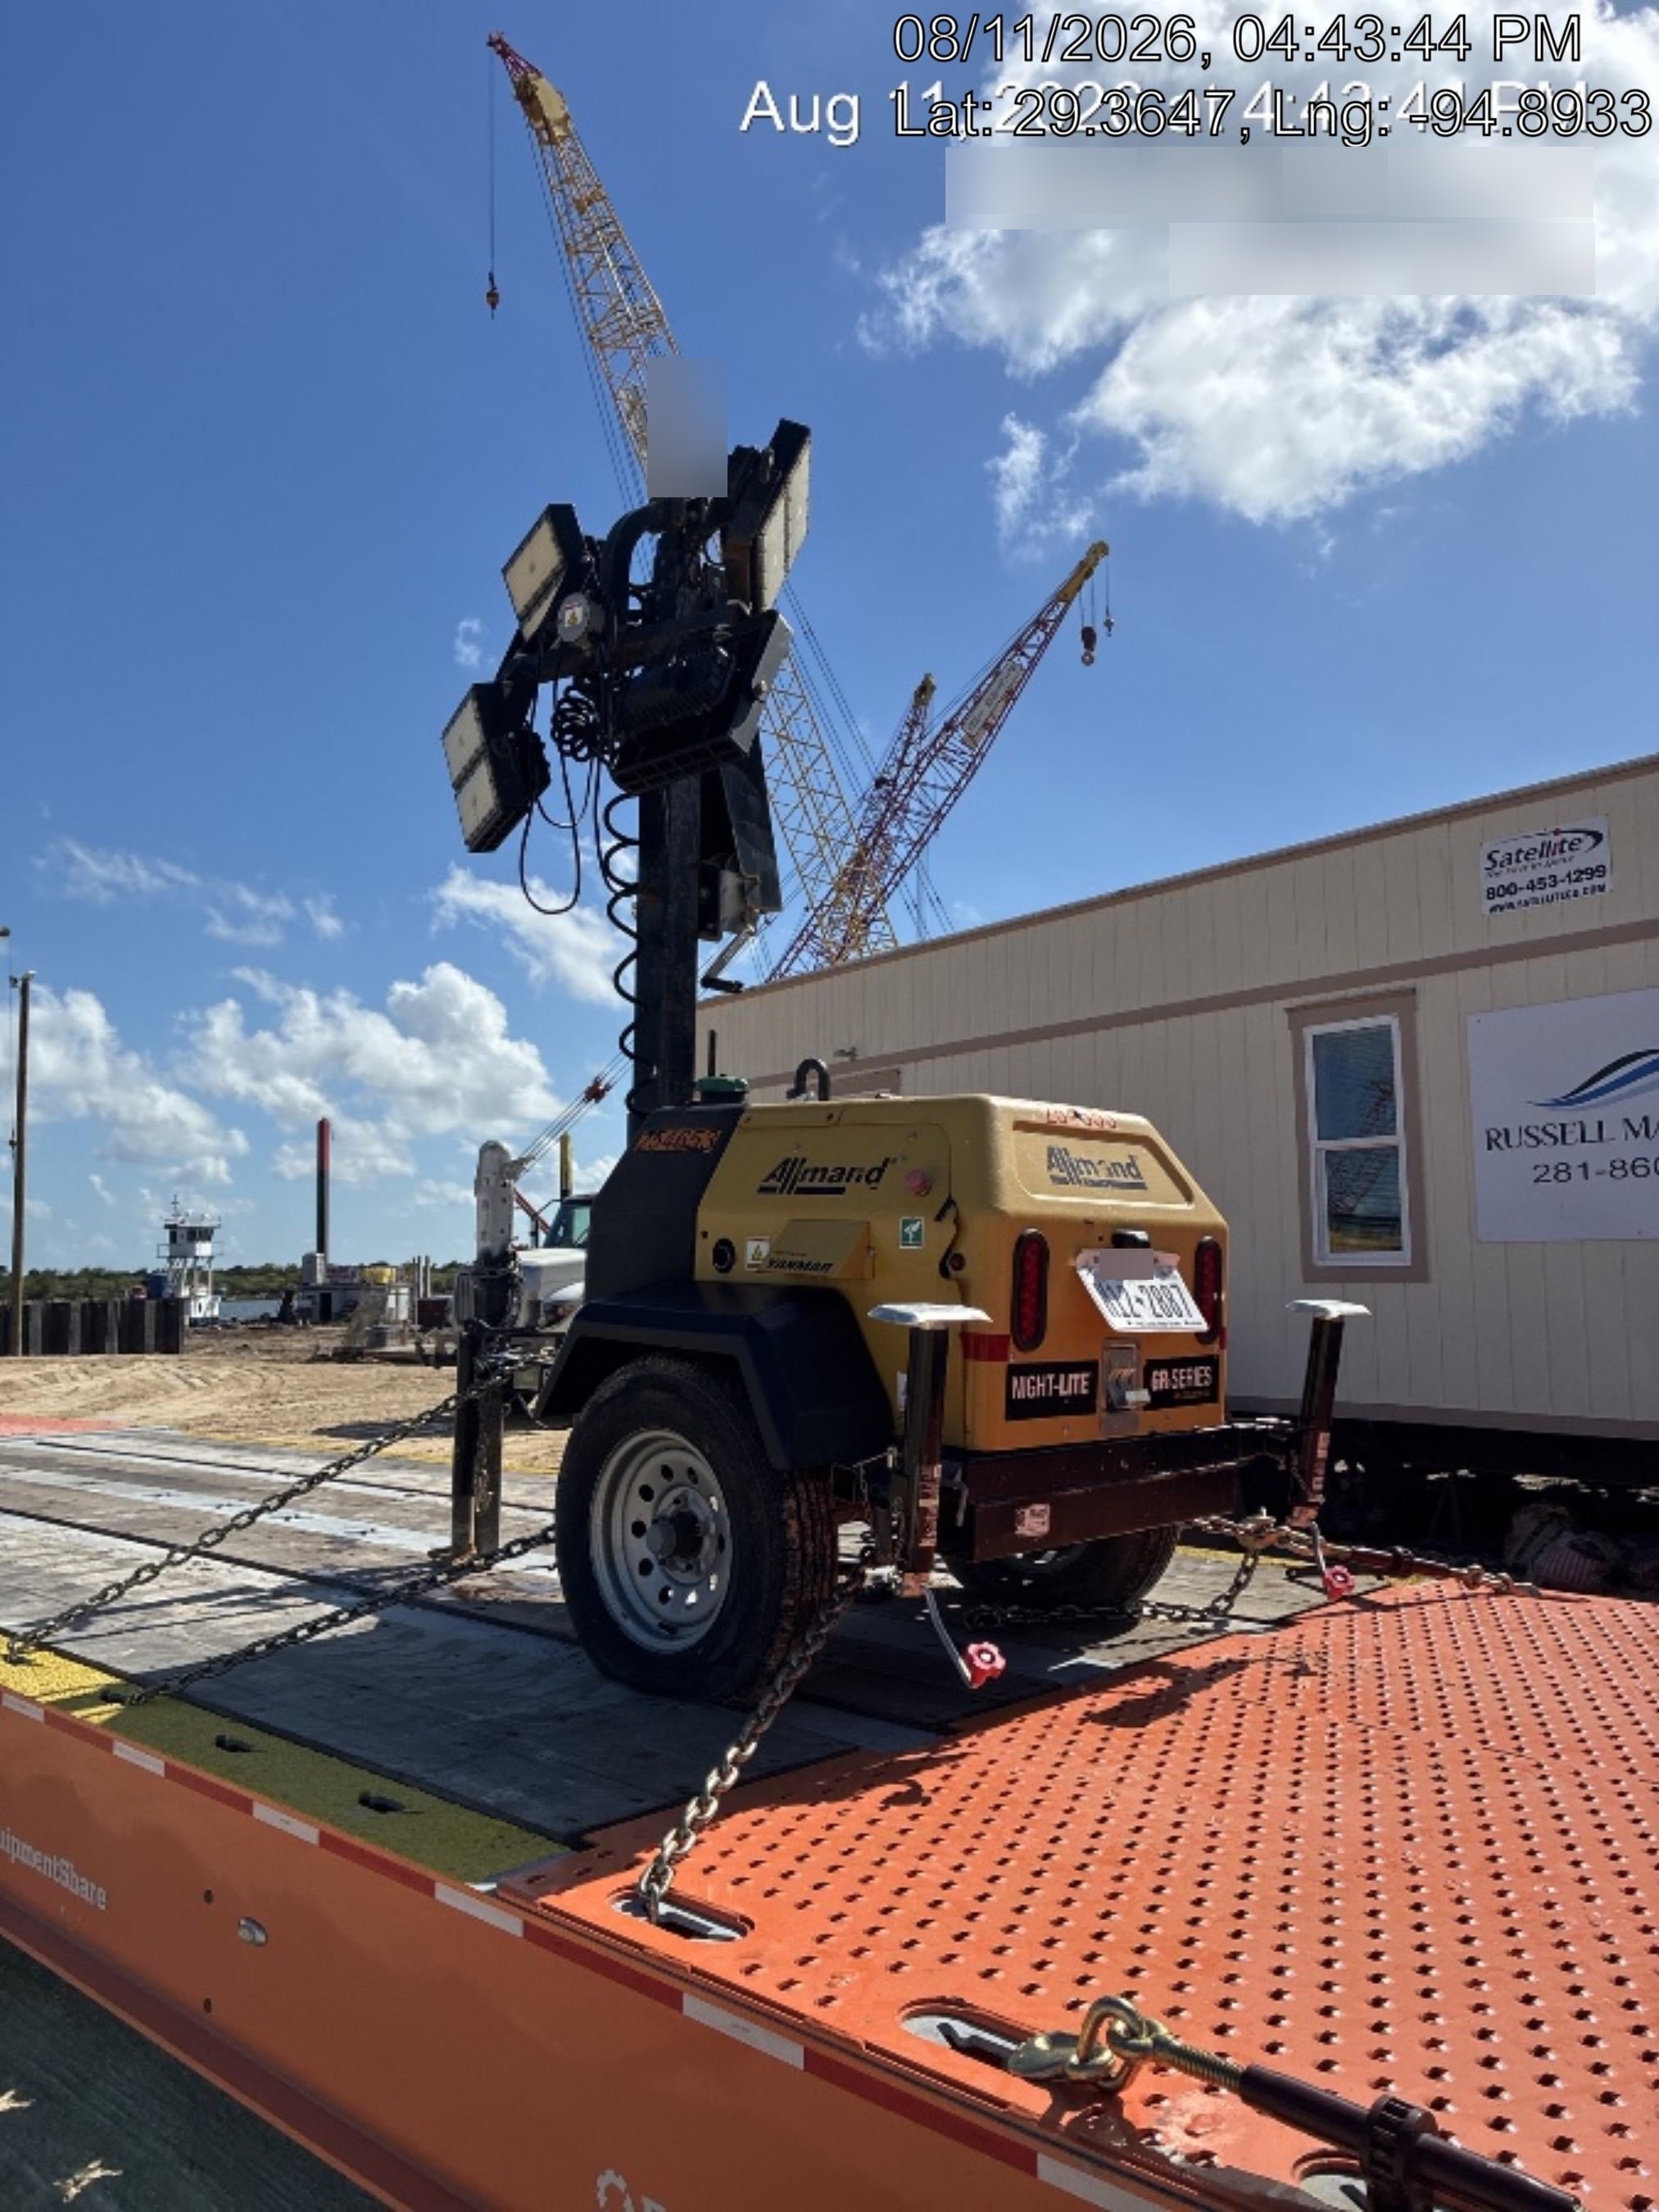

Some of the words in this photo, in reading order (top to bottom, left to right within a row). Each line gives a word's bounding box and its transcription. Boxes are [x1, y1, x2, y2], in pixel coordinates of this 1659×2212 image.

[1484, 836, 1583, 871] Satellite
[1486, 864, 1607, 900] 800-453-1299
[1484, 1119, 1616, 1150] RUSSELL
[758, 1157, 893, 1194] Allmand
[1532, 1156, 1659, 1184] 281-86
[1012, 1371, 1091, 1399] NIGHT-LITE
